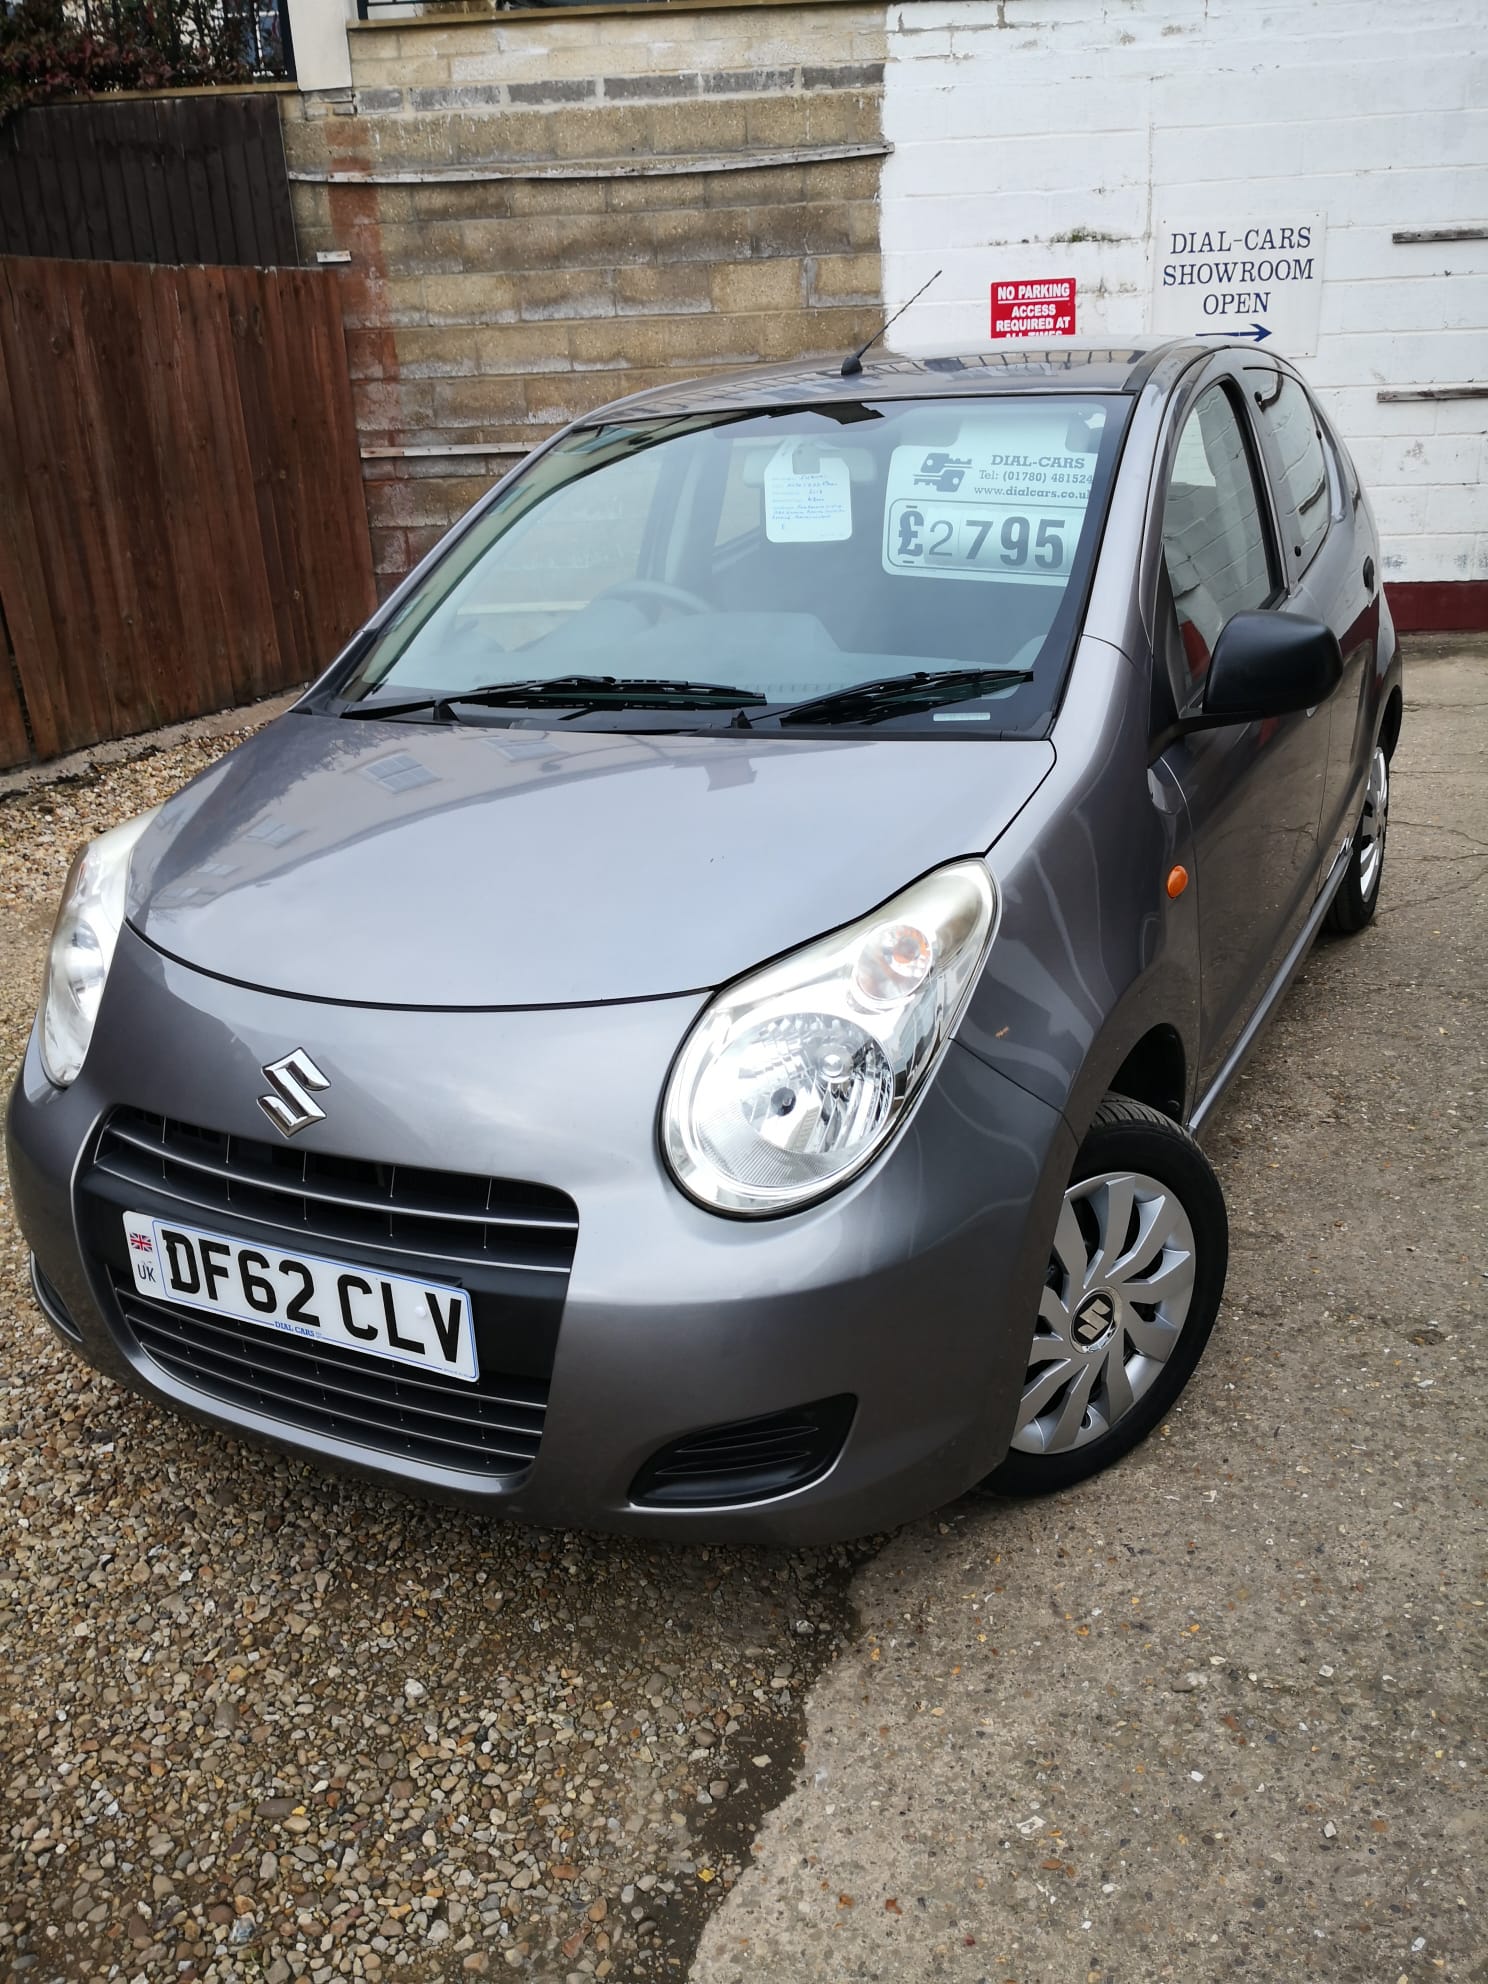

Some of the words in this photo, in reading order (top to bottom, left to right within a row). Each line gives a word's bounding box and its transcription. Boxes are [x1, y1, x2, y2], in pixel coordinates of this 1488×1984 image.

[1170, 226, 1312, 254] DIAL-CARS
[1163, 258, 1315, 286] SHOWROOM
[997, 285, 1014, 300] NO
[1018, 283, 1070, 299] PARKING
[1011, 304, 1056, 318] ACCESS
[1203, 292, 1271, 315] OPEN
[996, 317, 1054, 332] REQUIRED
[1055, 316, 1071, 329] AT
[991, 454, 1085, 469] DIAL-CARS
[979, 470, 999, 480] Tel:
[1002, 471, 1047, 484] (01780)
[974, 486, 1090, 499] www.dialcars.co.u
[897, 510, 1066, 570] £2795
[137, 1263, 156, 1283] UK
[162, 1228, 321, 1328] DF62
[337, 1273, 462, 1364] CLV
